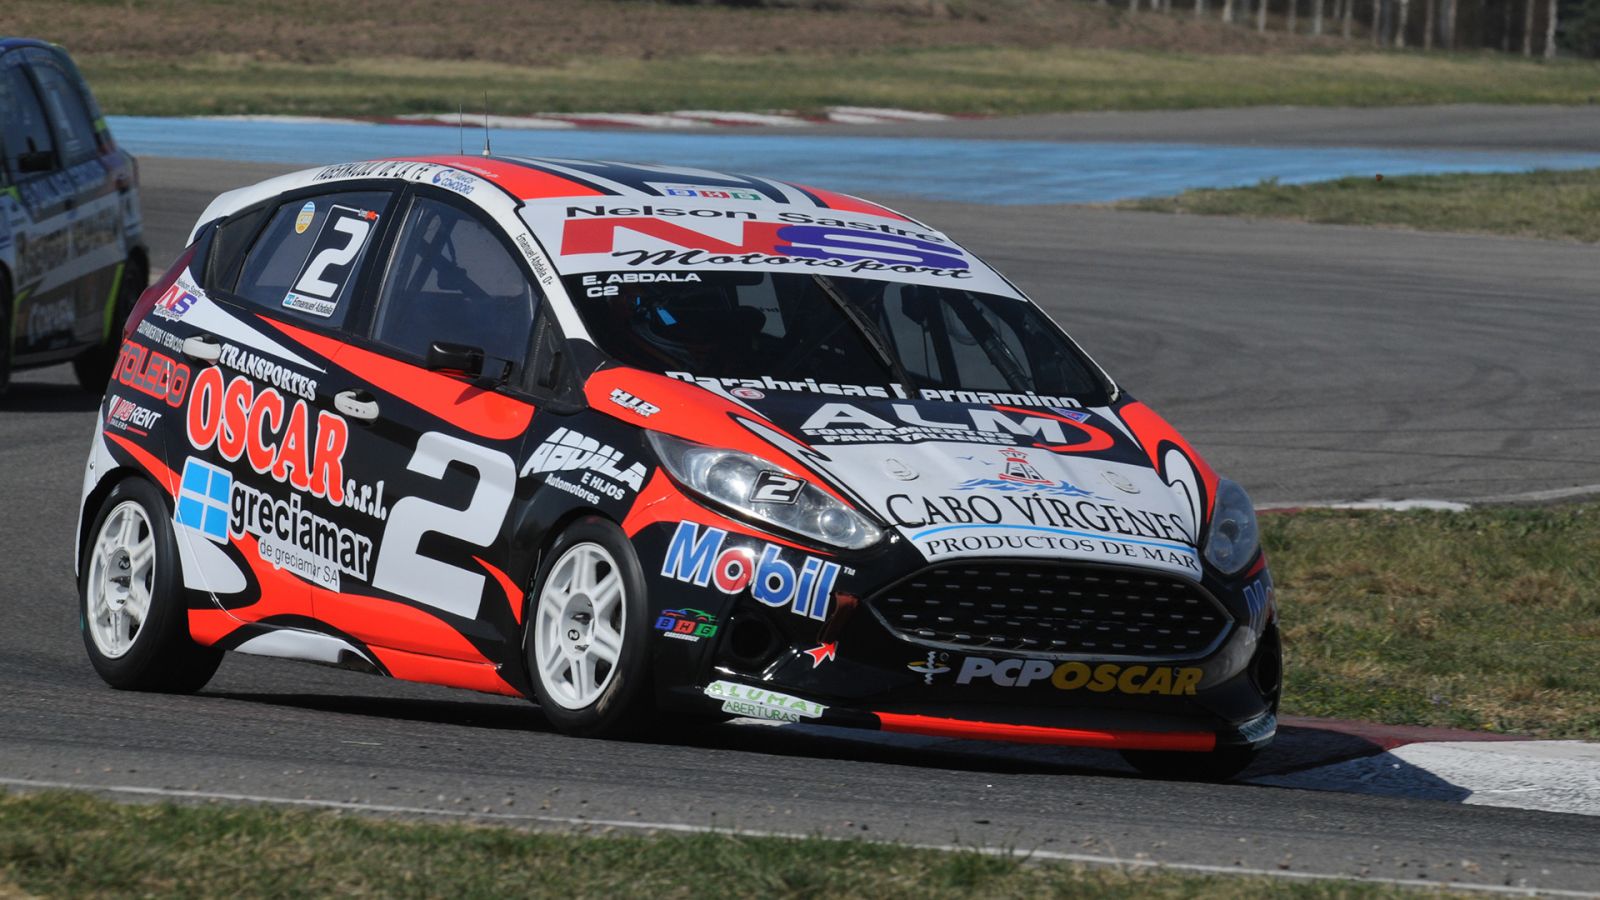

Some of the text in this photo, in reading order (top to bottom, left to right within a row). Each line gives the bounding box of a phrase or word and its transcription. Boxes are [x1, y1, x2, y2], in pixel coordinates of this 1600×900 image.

[566, 205, 945, 243] Nelson Sastre
[296, 216, 370, 298] 2
[560, 217, 969, 269] NS
[530, 255, 548, 278] Abdala
[582, 273, 701, 286] E. ABDALA
[612, 249, 973, 279] Motorsport
[156, 284, 198, 315] NS
[292, 296, 334, 315] Emanuel Abdala
[586, 285, 619, 298] C2
[112, 338, 191, 409] TOLEDO
[219, 343, 318, 401] TRANSPORTES
[129, 405, 161, 430] RENT
[800, 403, 1067, 443] ALM
[803, 426, 1015, 439] EQUIPAMIENTOS
[187, 365, 387, 520] OSCAR s.r.l.
[822, 432, 1018, 445] PARA TALLERES
[519, 426, 648, 493] ABDALA
[544, 472, 600, 505] Automotores
[581, 471, 625, 500] E HIJOS
[755, 475, 800, 501] 2
[372, 431, 517, 620] 2
[886, 494, 1003, 528] CABO
[229, 484, 373, 577] greciamar
[259, 539, 338, 587] de greciamar SA
[660, 519, 841, 622] Mobil
[925, 535, 1199, 572] PRODUCTOS DE MAR
[724, 700, 798, 723] ABERTURAS
